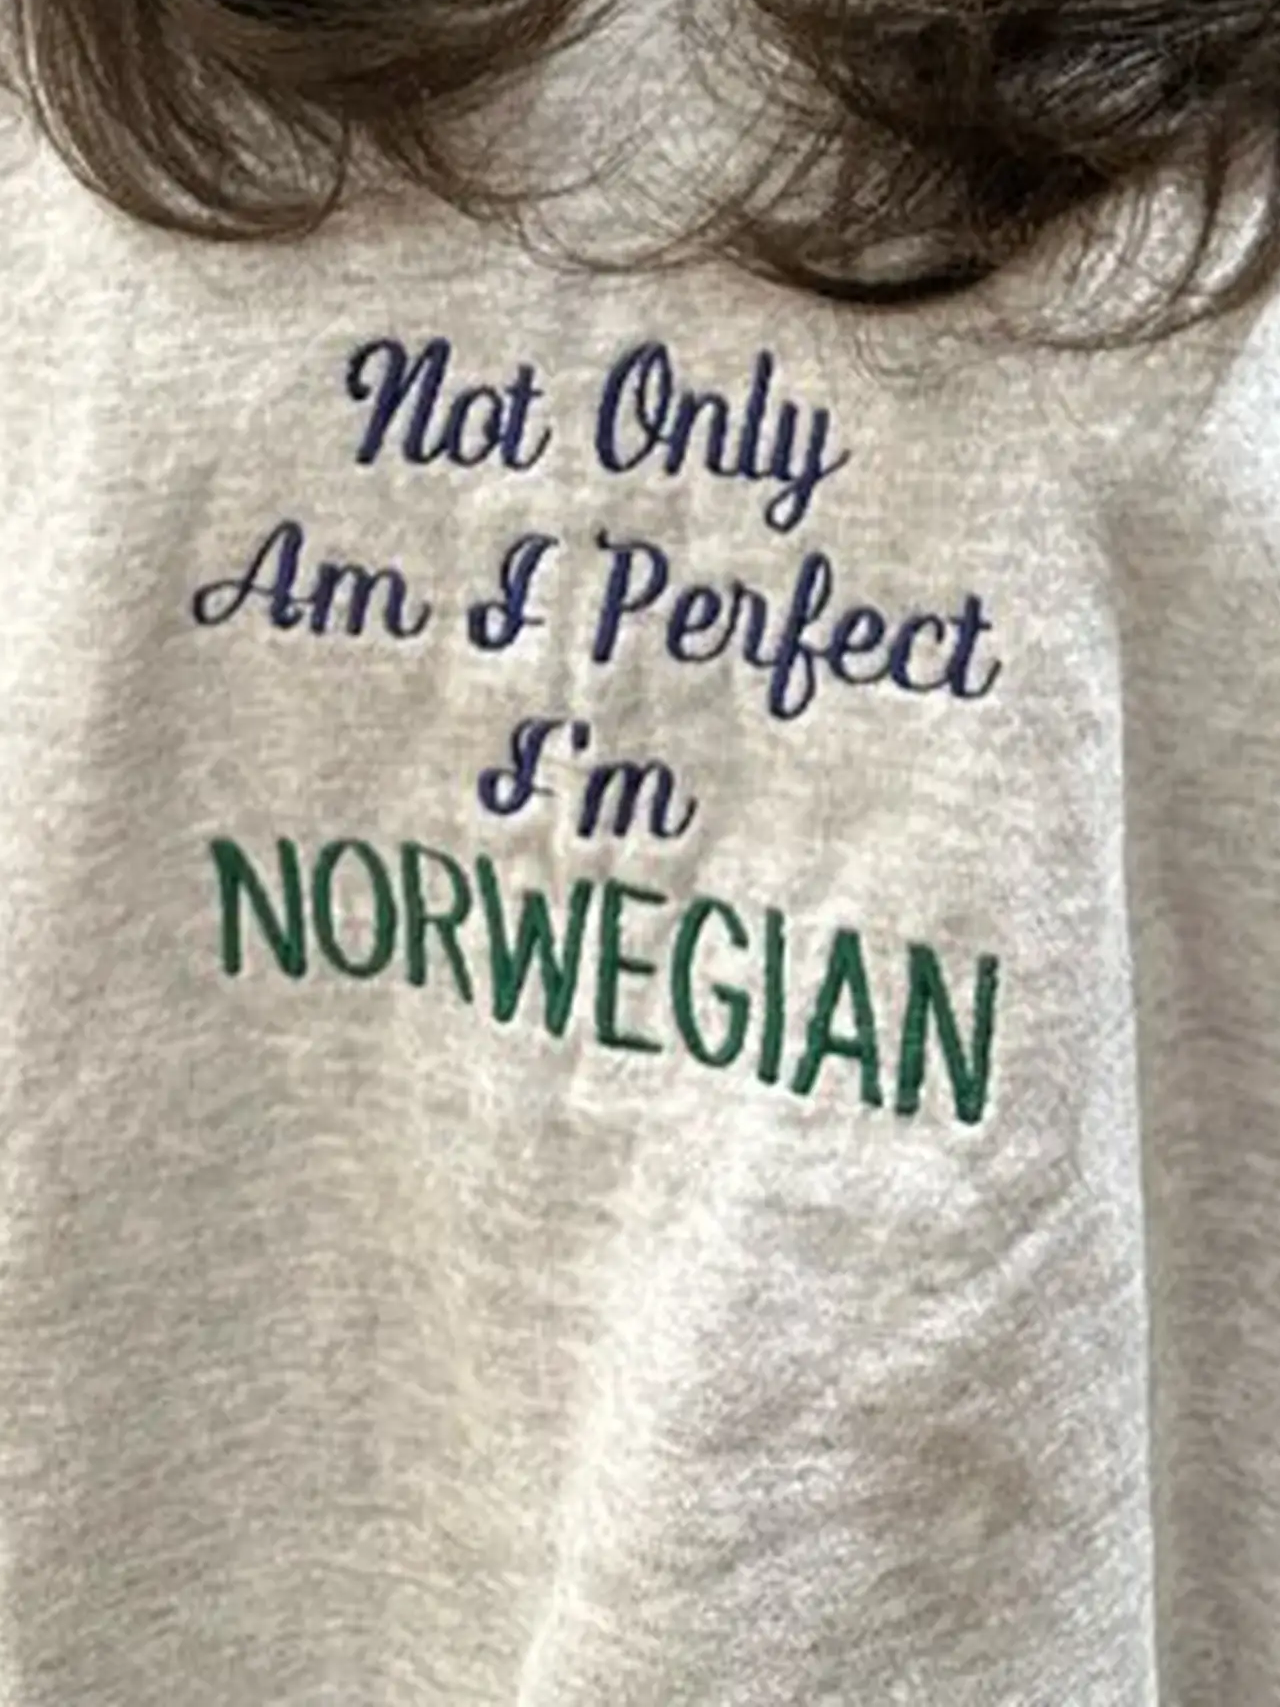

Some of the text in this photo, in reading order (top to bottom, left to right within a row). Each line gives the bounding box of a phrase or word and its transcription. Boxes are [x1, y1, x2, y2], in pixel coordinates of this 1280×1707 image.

[346, 337, 850, 533] Not Only
[192, 520, 1001, 720] Am I Perfect
[477, 718, 696, 839] I'm
[209, 837, 999, 1125] NORWEGIAN
